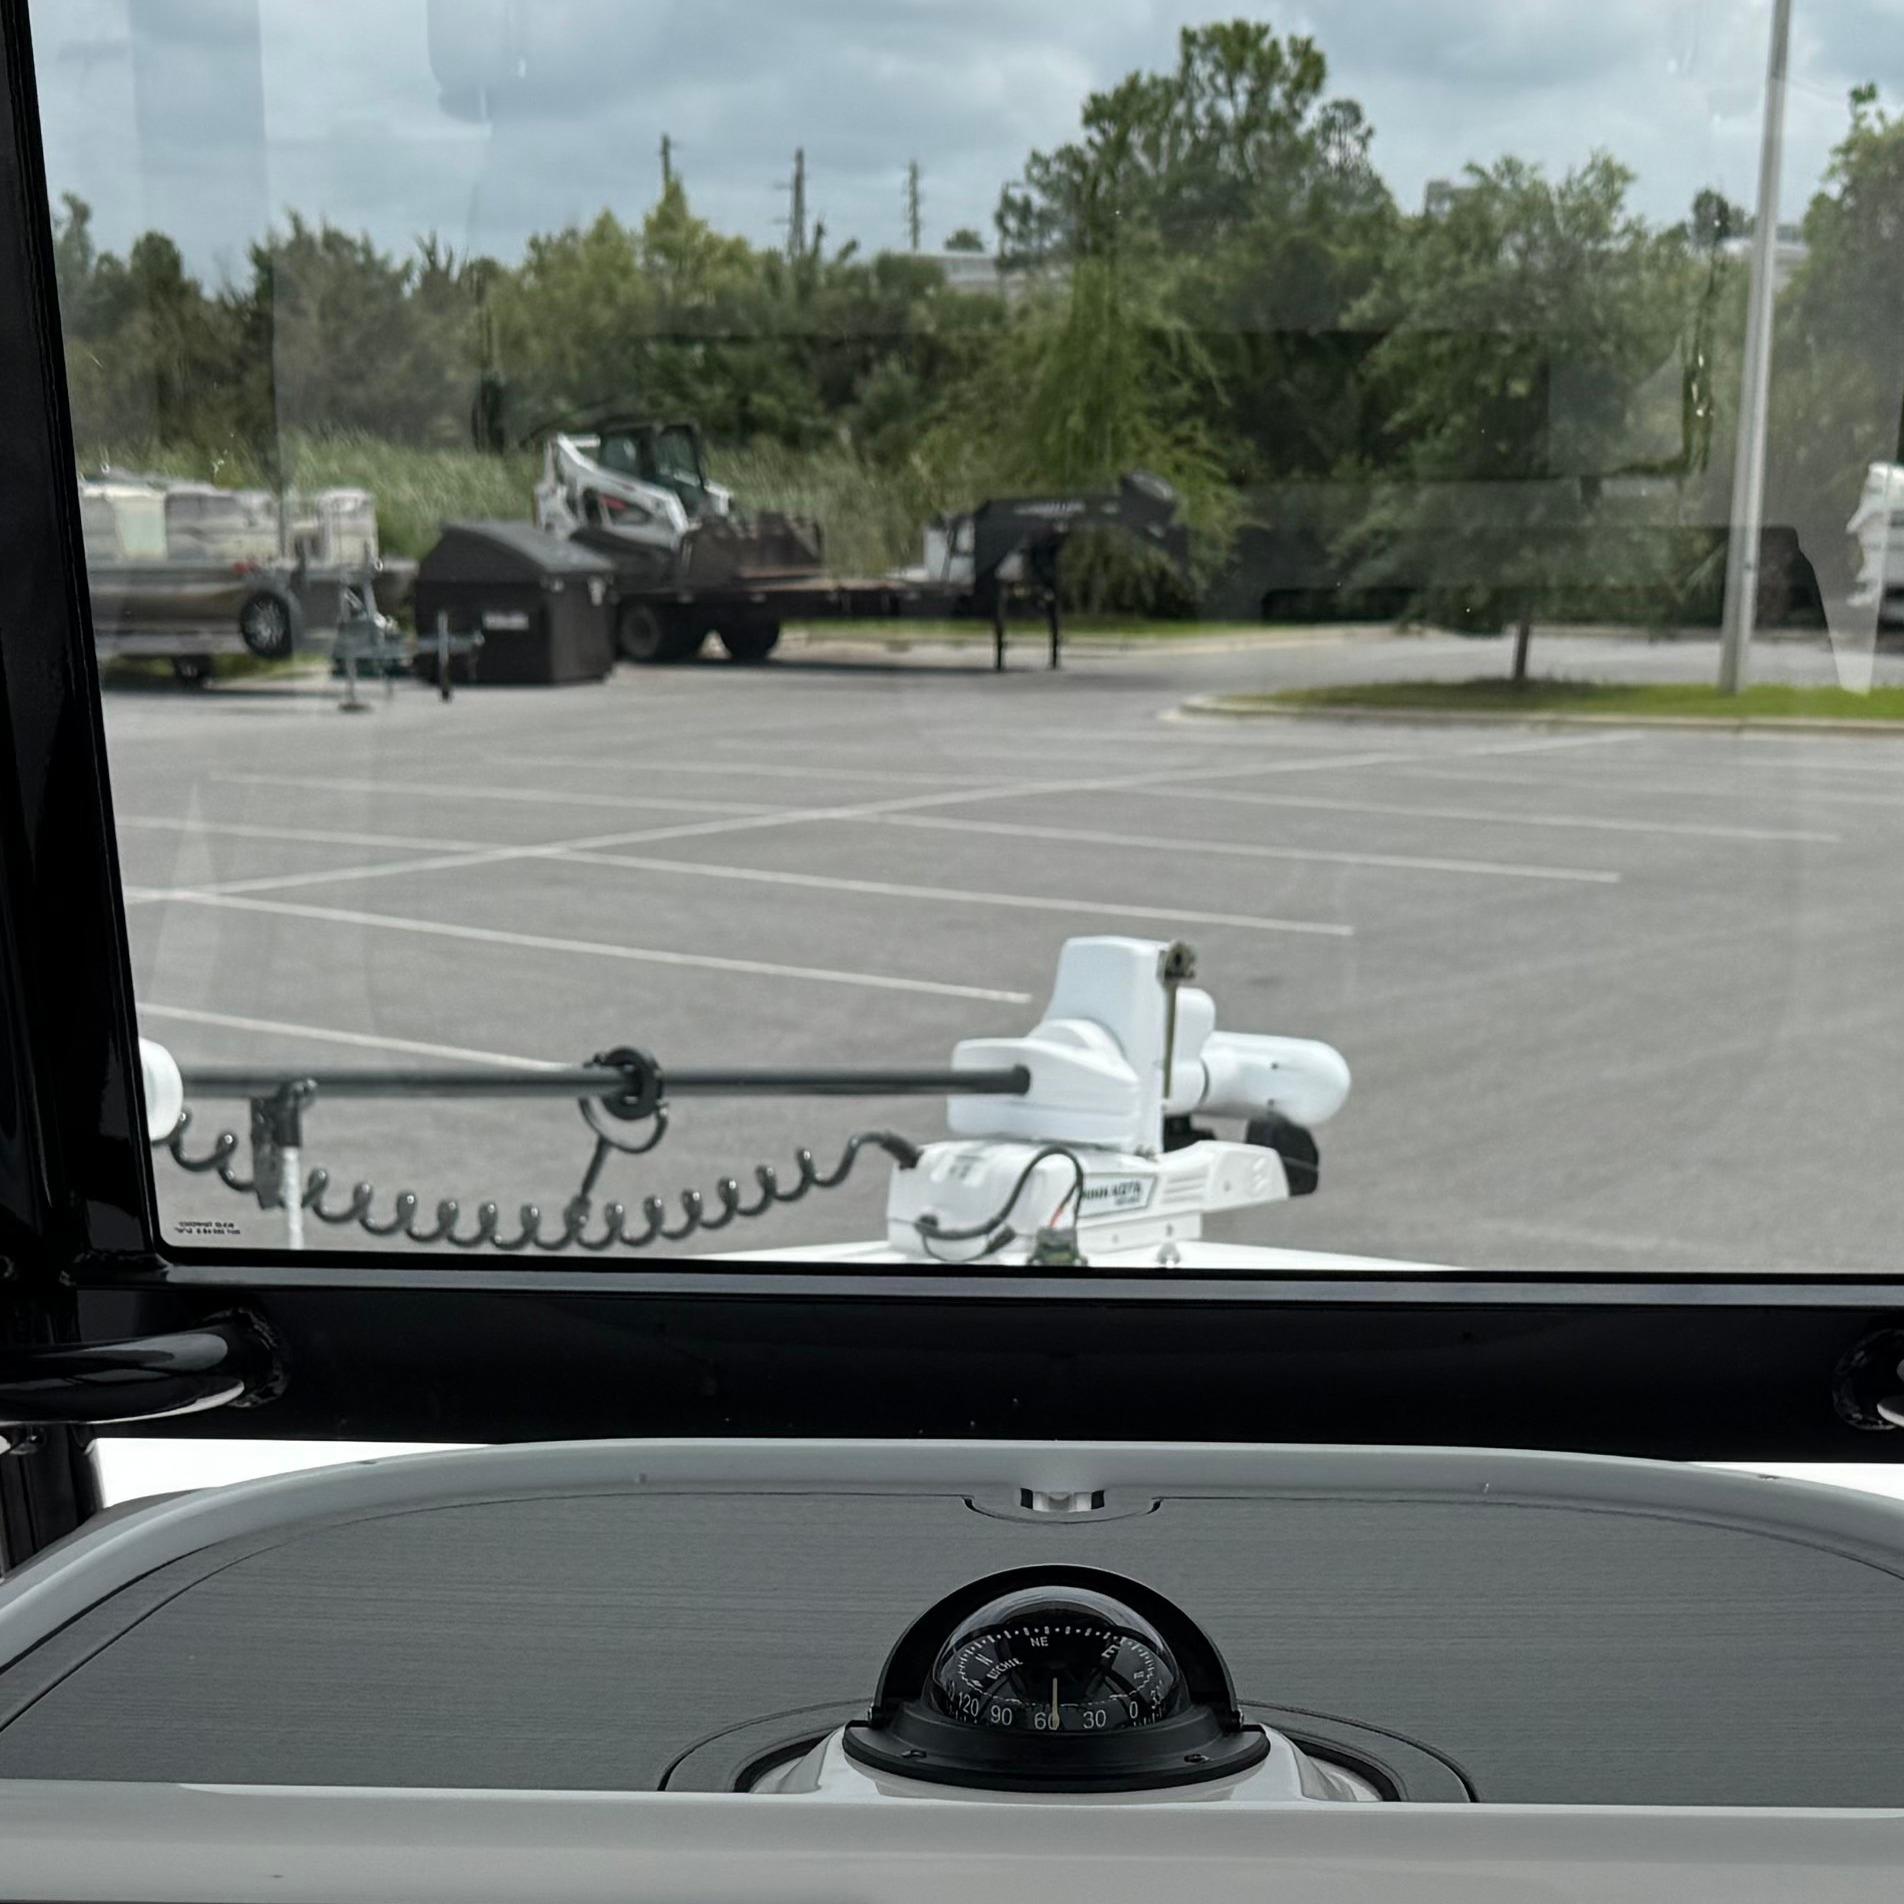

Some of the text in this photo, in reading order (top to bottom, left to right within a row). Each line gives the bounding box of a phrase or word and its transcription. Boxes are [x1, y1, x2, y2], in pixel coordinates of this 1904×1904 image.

[1029, 1636, 1049, 1647] NE
[959, 1692, 1138, 1731] 120 90 60 30 0
